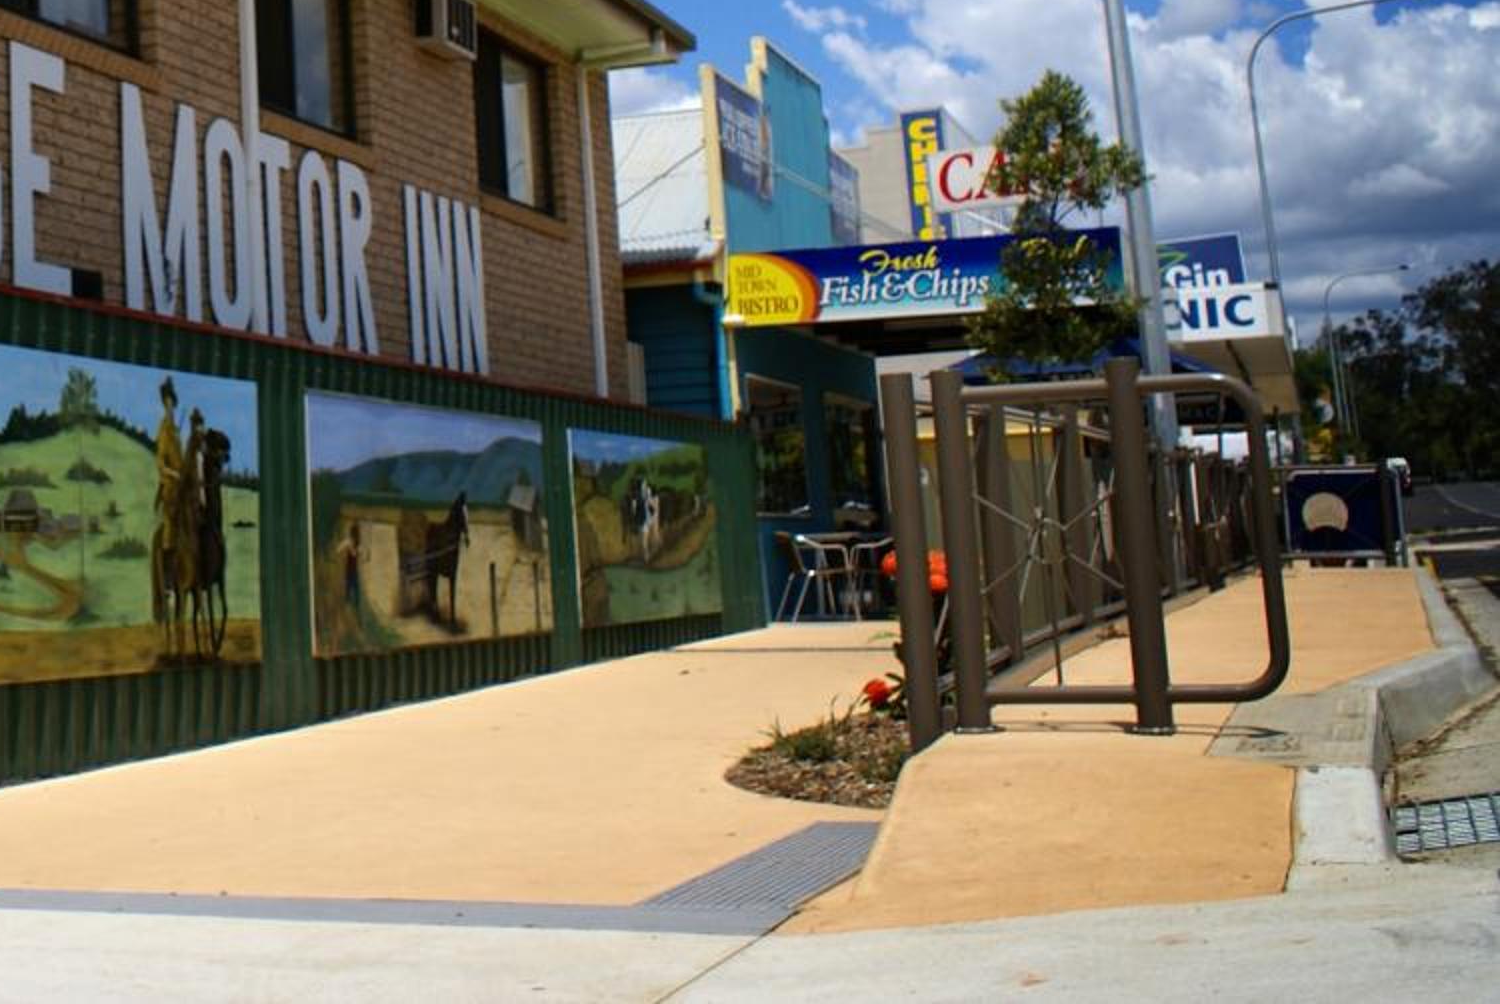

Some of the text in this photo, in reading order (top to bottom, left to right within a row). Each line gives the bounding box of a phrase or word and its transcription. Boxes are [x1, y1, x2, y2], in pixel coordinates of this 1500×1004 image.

[121, 82, 380, 356] MOTOR
[404, 184, 490, 376] INN
[858, 245, 940, 277] Fresh
[1165, 261, 1230, 288] Gin
[738, 278, 777, 294] TOWN
[738, 295, 799, 316] BISTRO
